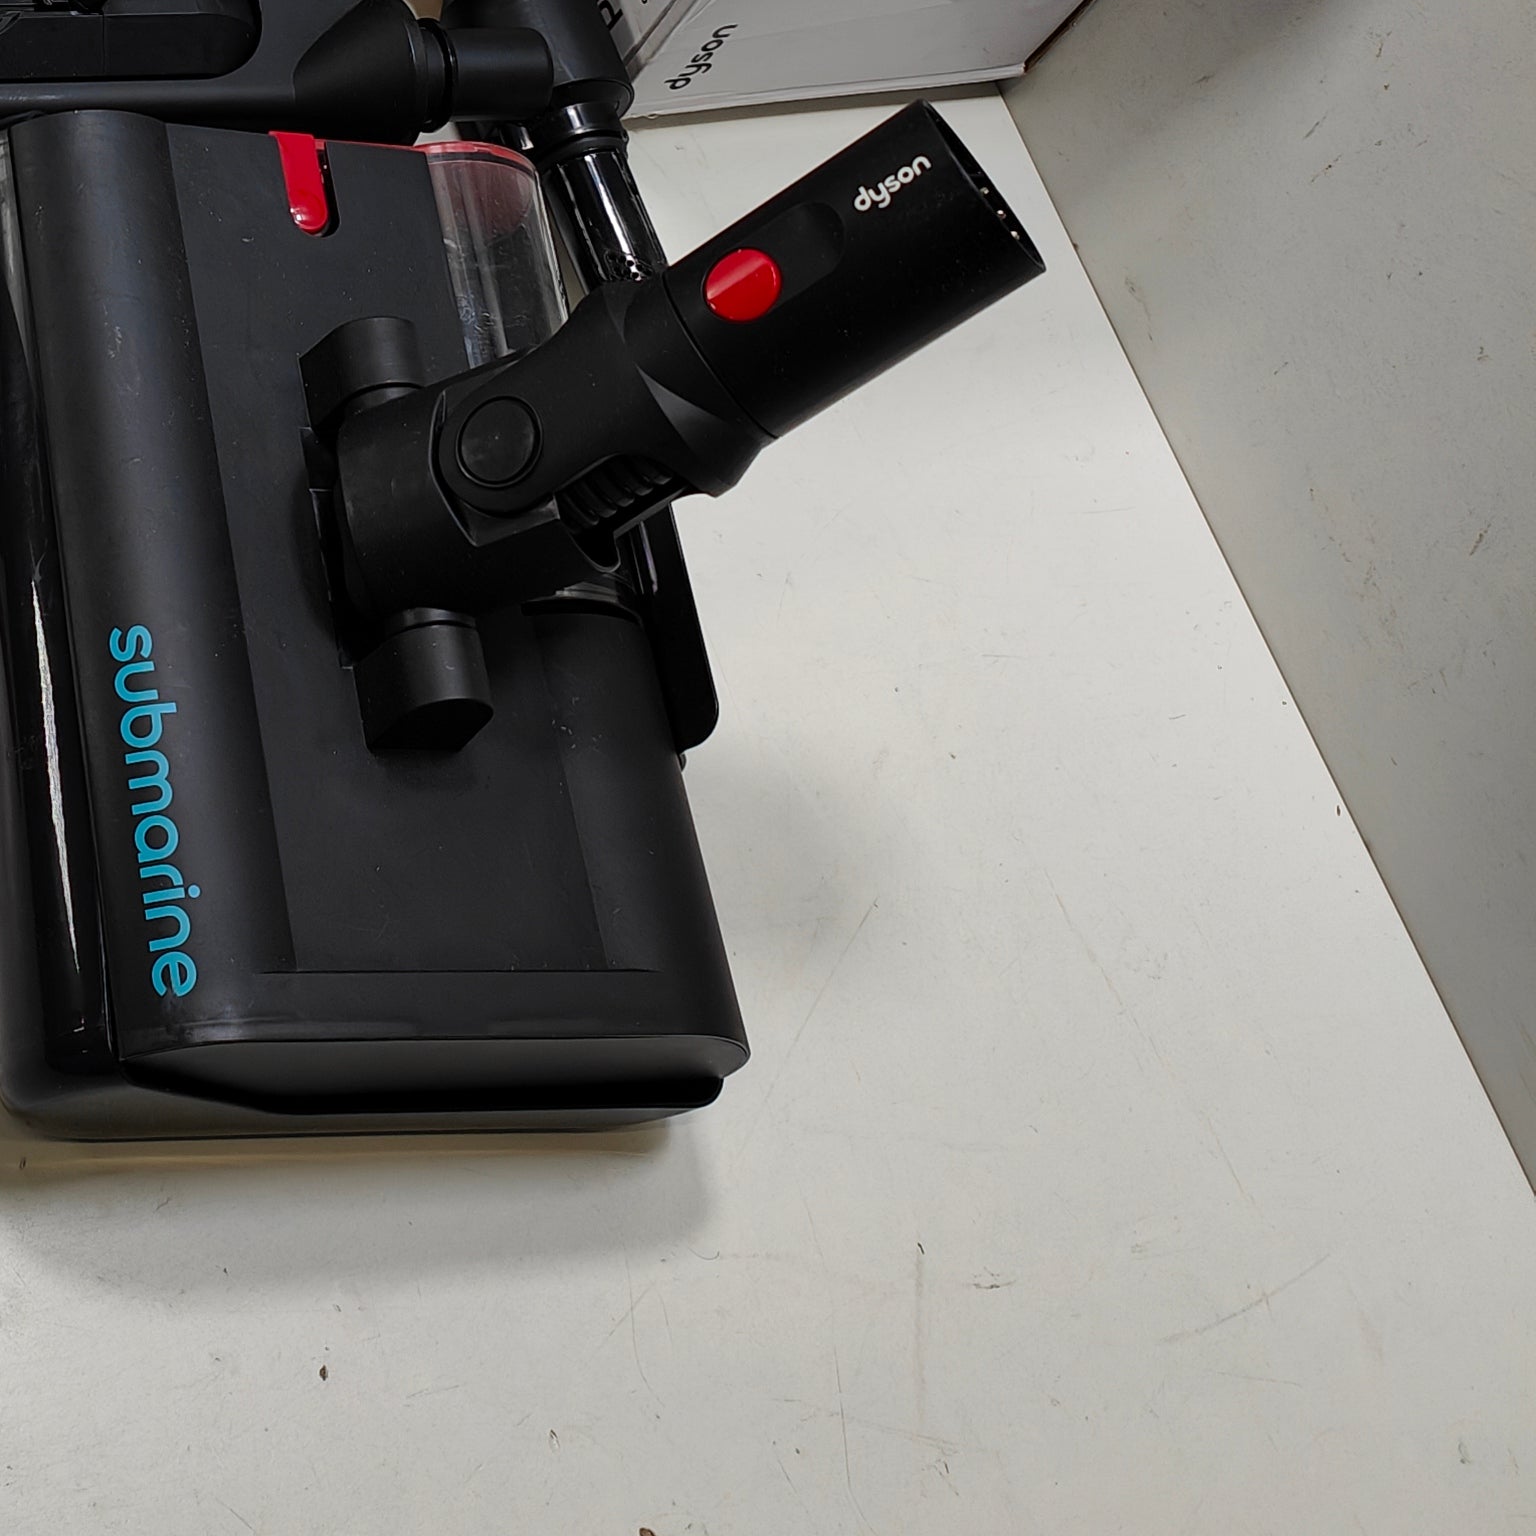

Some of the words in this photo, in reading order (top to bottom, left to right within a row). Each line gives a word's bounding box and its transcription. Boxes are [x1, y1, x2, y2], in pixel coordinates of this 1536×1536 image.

[664, 24, 739, 90] dyson
[853, 155, 932, 212] dyson
[108, 624, 202, 998] submarine
